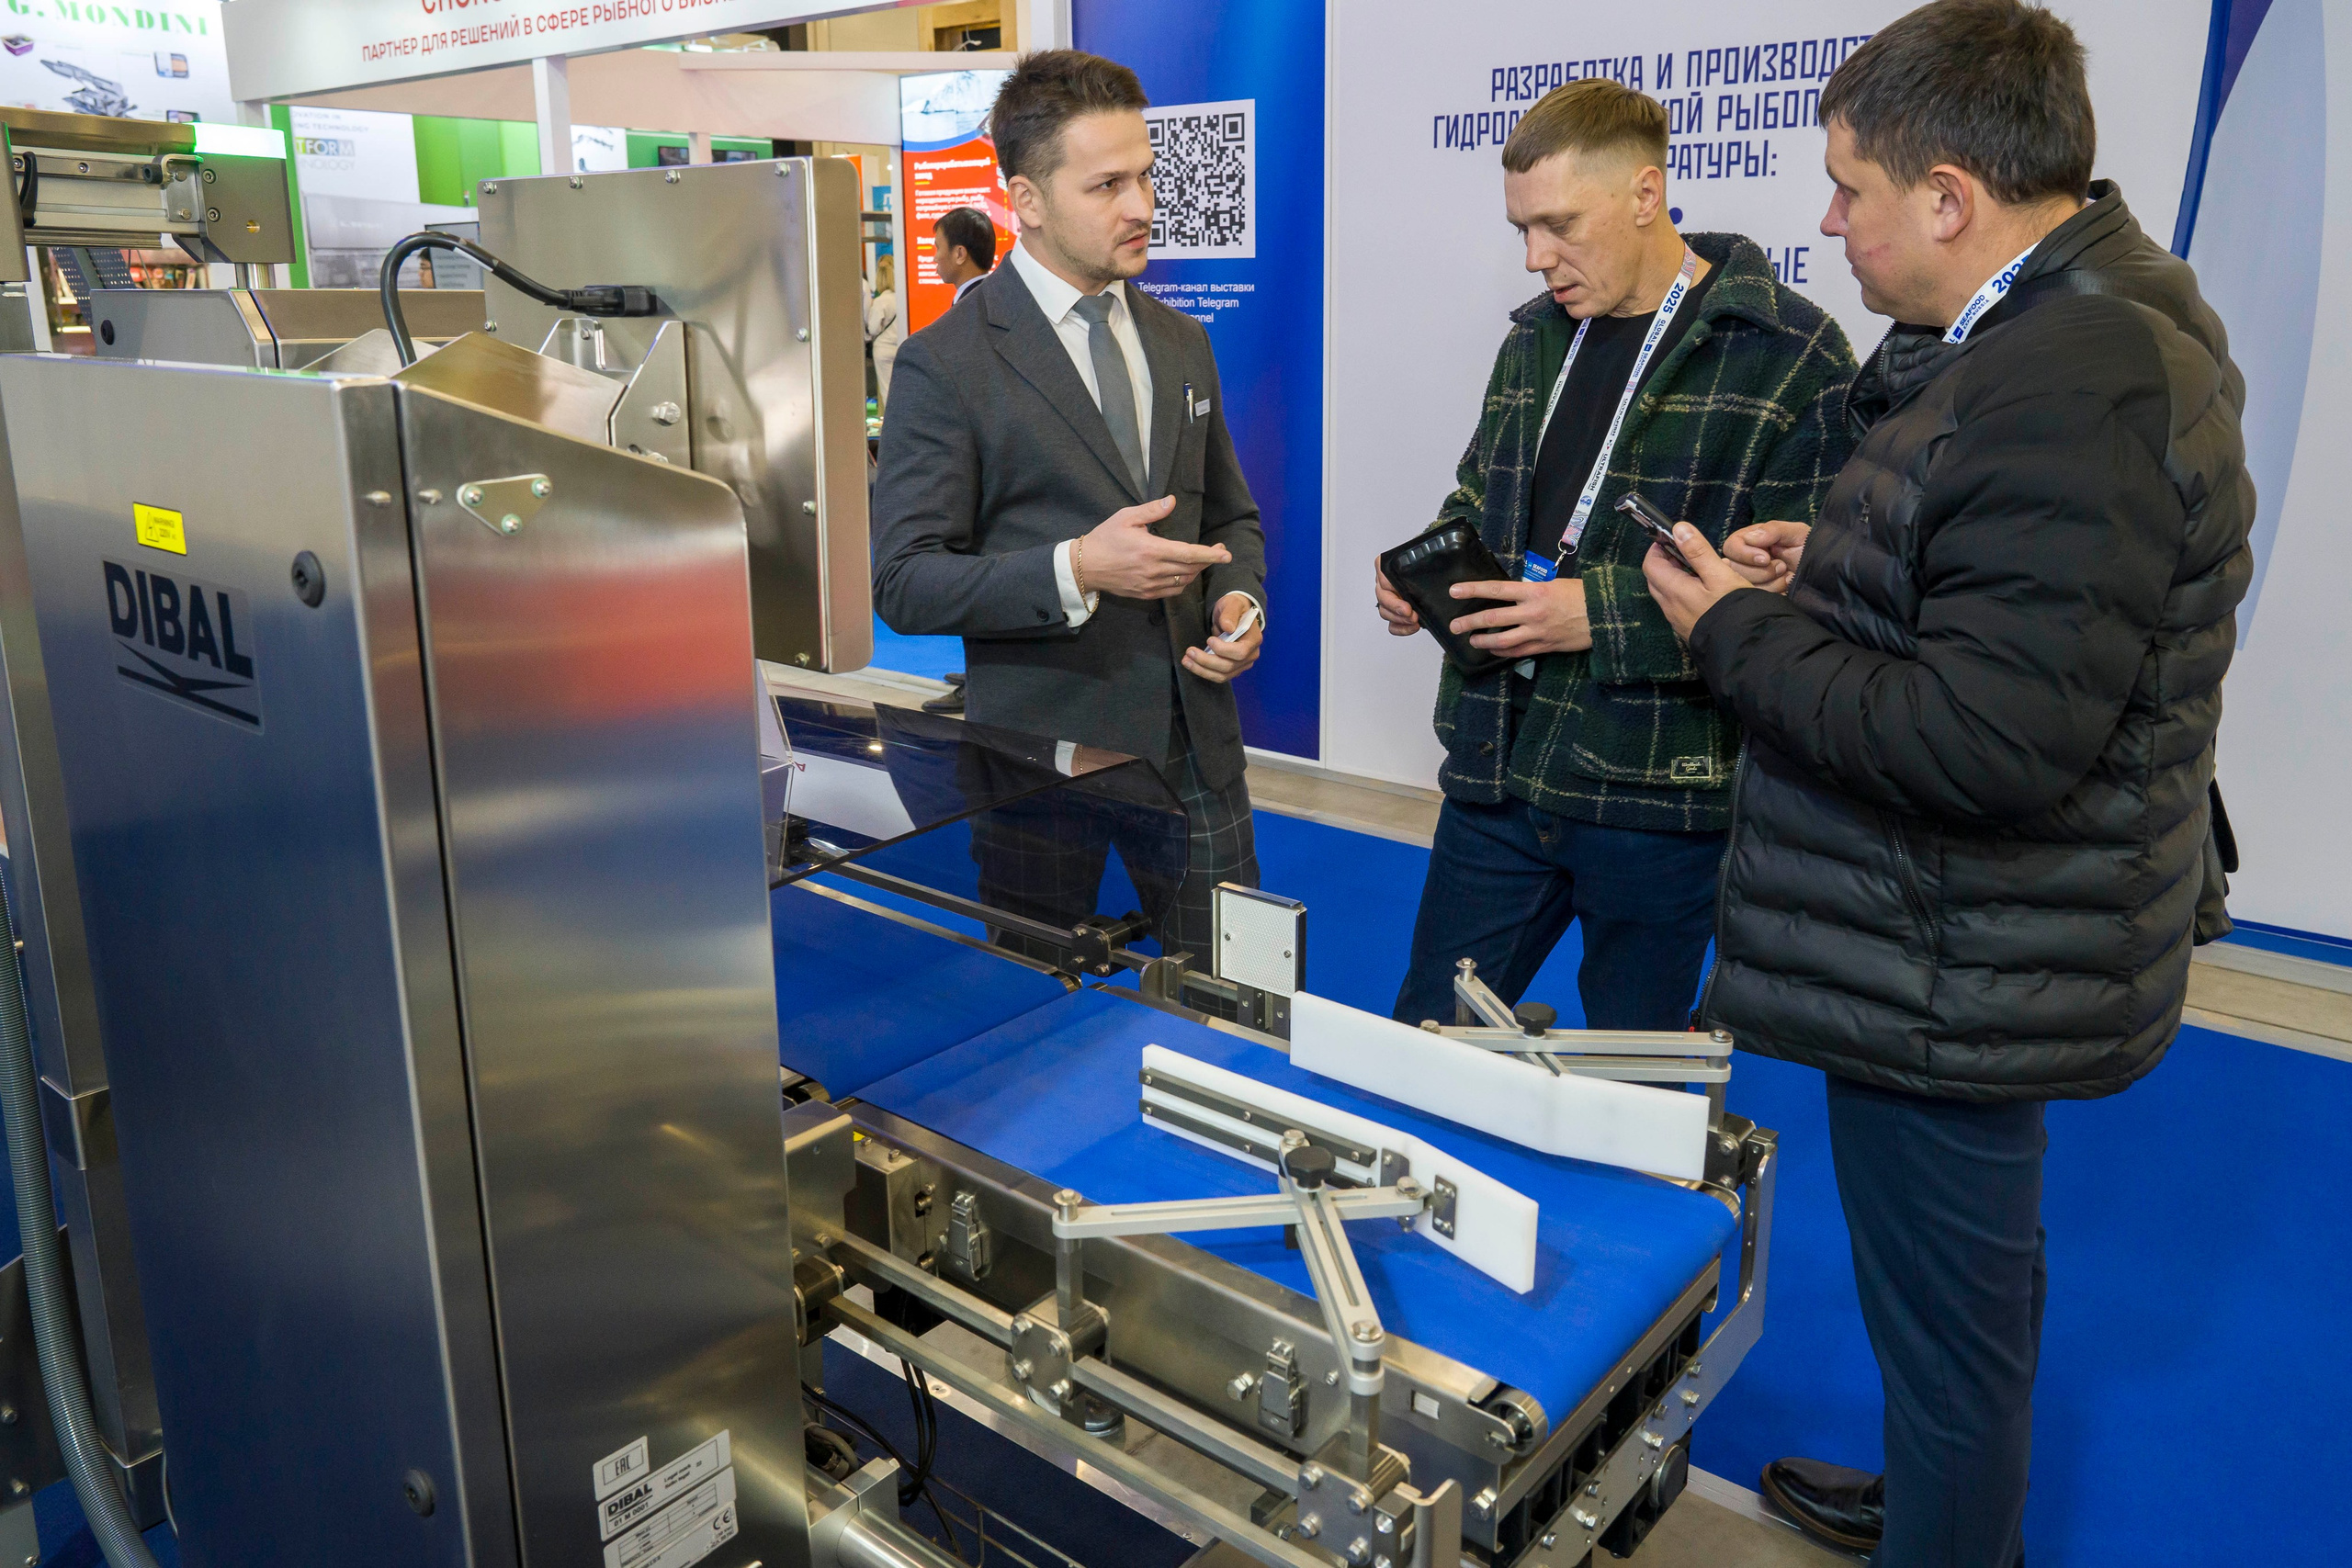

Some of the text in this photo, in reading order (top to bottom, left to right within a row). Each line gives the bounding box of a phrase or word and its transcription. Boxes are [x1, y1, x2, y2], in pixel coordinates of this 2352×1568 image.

[55, 0, 208, 35] MONDINI
[362, 38, 417, 62] ПАРТНЕР
[421, 32, 448, 56] ДЛЯ
[451, 14, 520, 47] РЕШЕНИЙ
[524, 17, 533, 35] В
[537, 7, 589, 33] СФЕРЕ
[1657, 52, 1673, 90] И
[1686, 35, 1875, 88] ПРОИЗВОДС
[1716, 88, 1821, 132] РЫБОП
[1137, 281, 1255, 295] Telegram-канал выставки
[1196, 297, 1239, 310] Telegram
[1663, 282, 1684, 314] 2025
[1959, 294, 1985, 327] SEAFOOD
[1650, 319, 1667, 344] GLOBAL
[1590, 453, 1608, 491] ULTRAFISH
[103, 560, 254, 680] DIBAL
[607, 1483, 652, 1515] DIBAL
